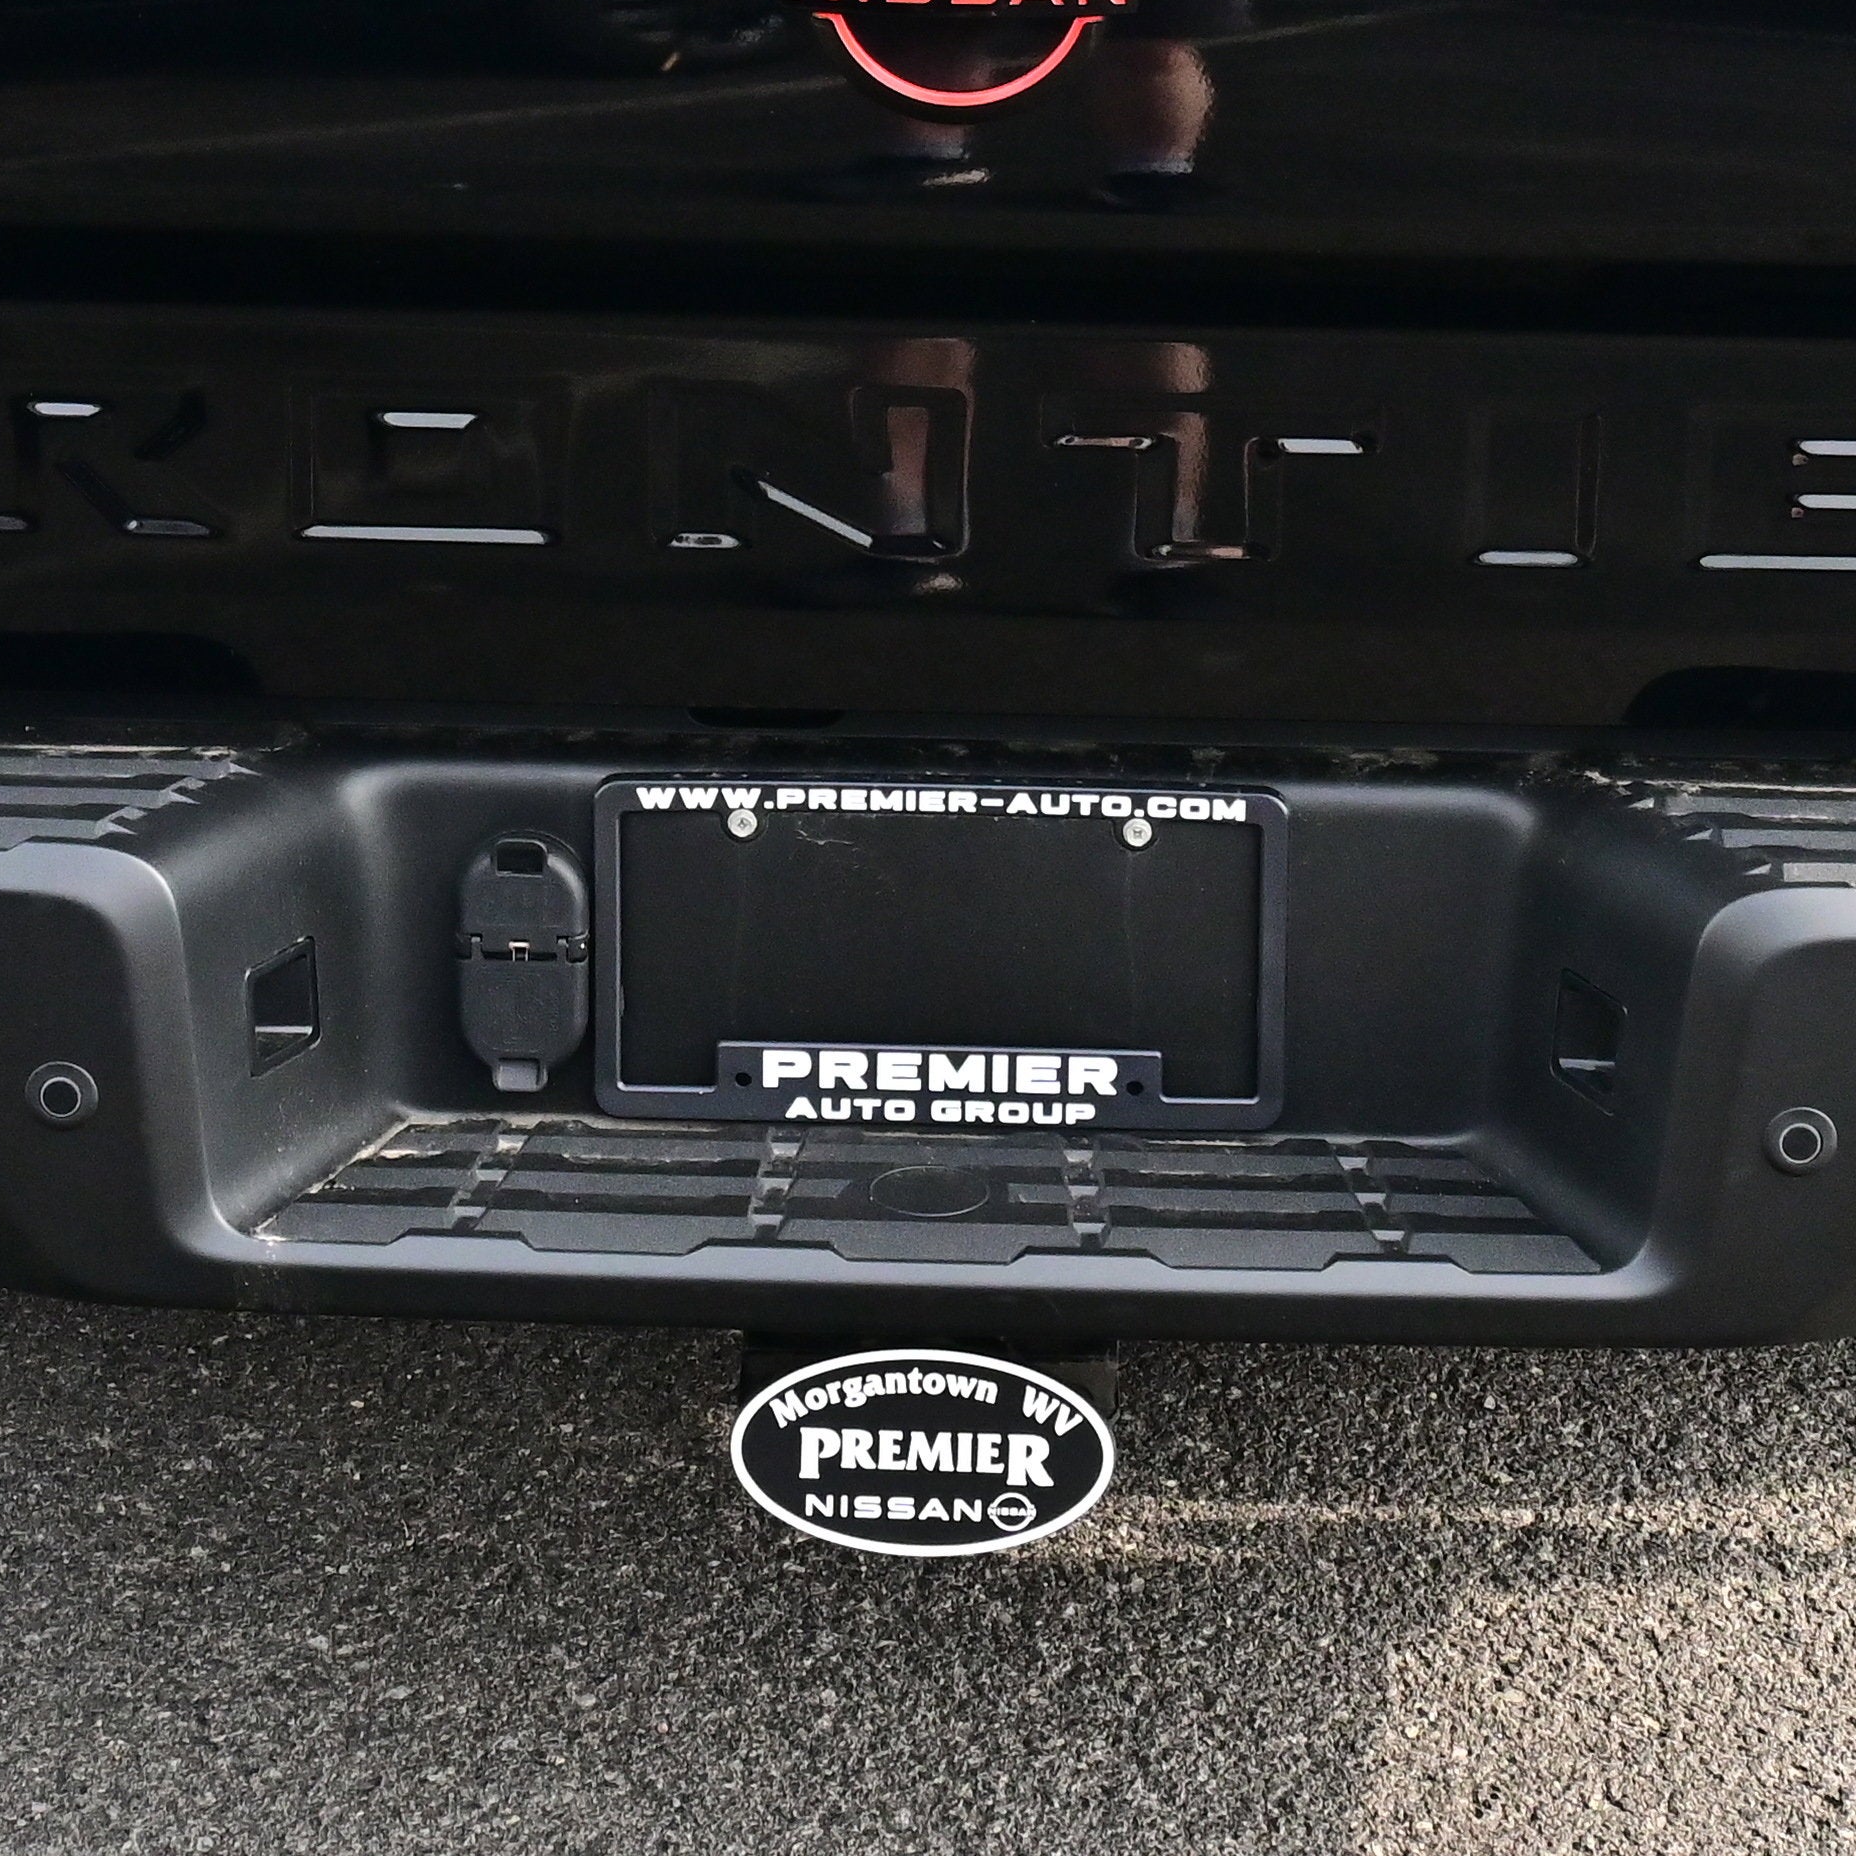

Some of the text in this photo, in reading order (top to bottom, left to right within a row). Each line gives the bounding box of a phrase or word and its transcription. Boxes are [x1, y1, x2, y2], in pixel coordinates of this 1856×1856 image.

[635, 786, 1247, 822] WWW.PREMIER-AUTO.COM
[761, 1049, 1119, 1096] PREMIER
[784, 1096, 1097, 1126] AUTO GROUP
[768, 1367, 1084, 1437] Morgantown WV
[798, 1426, 1055, 1487] PREMIER
[805, 1492, 983, 1523] NISSAN
